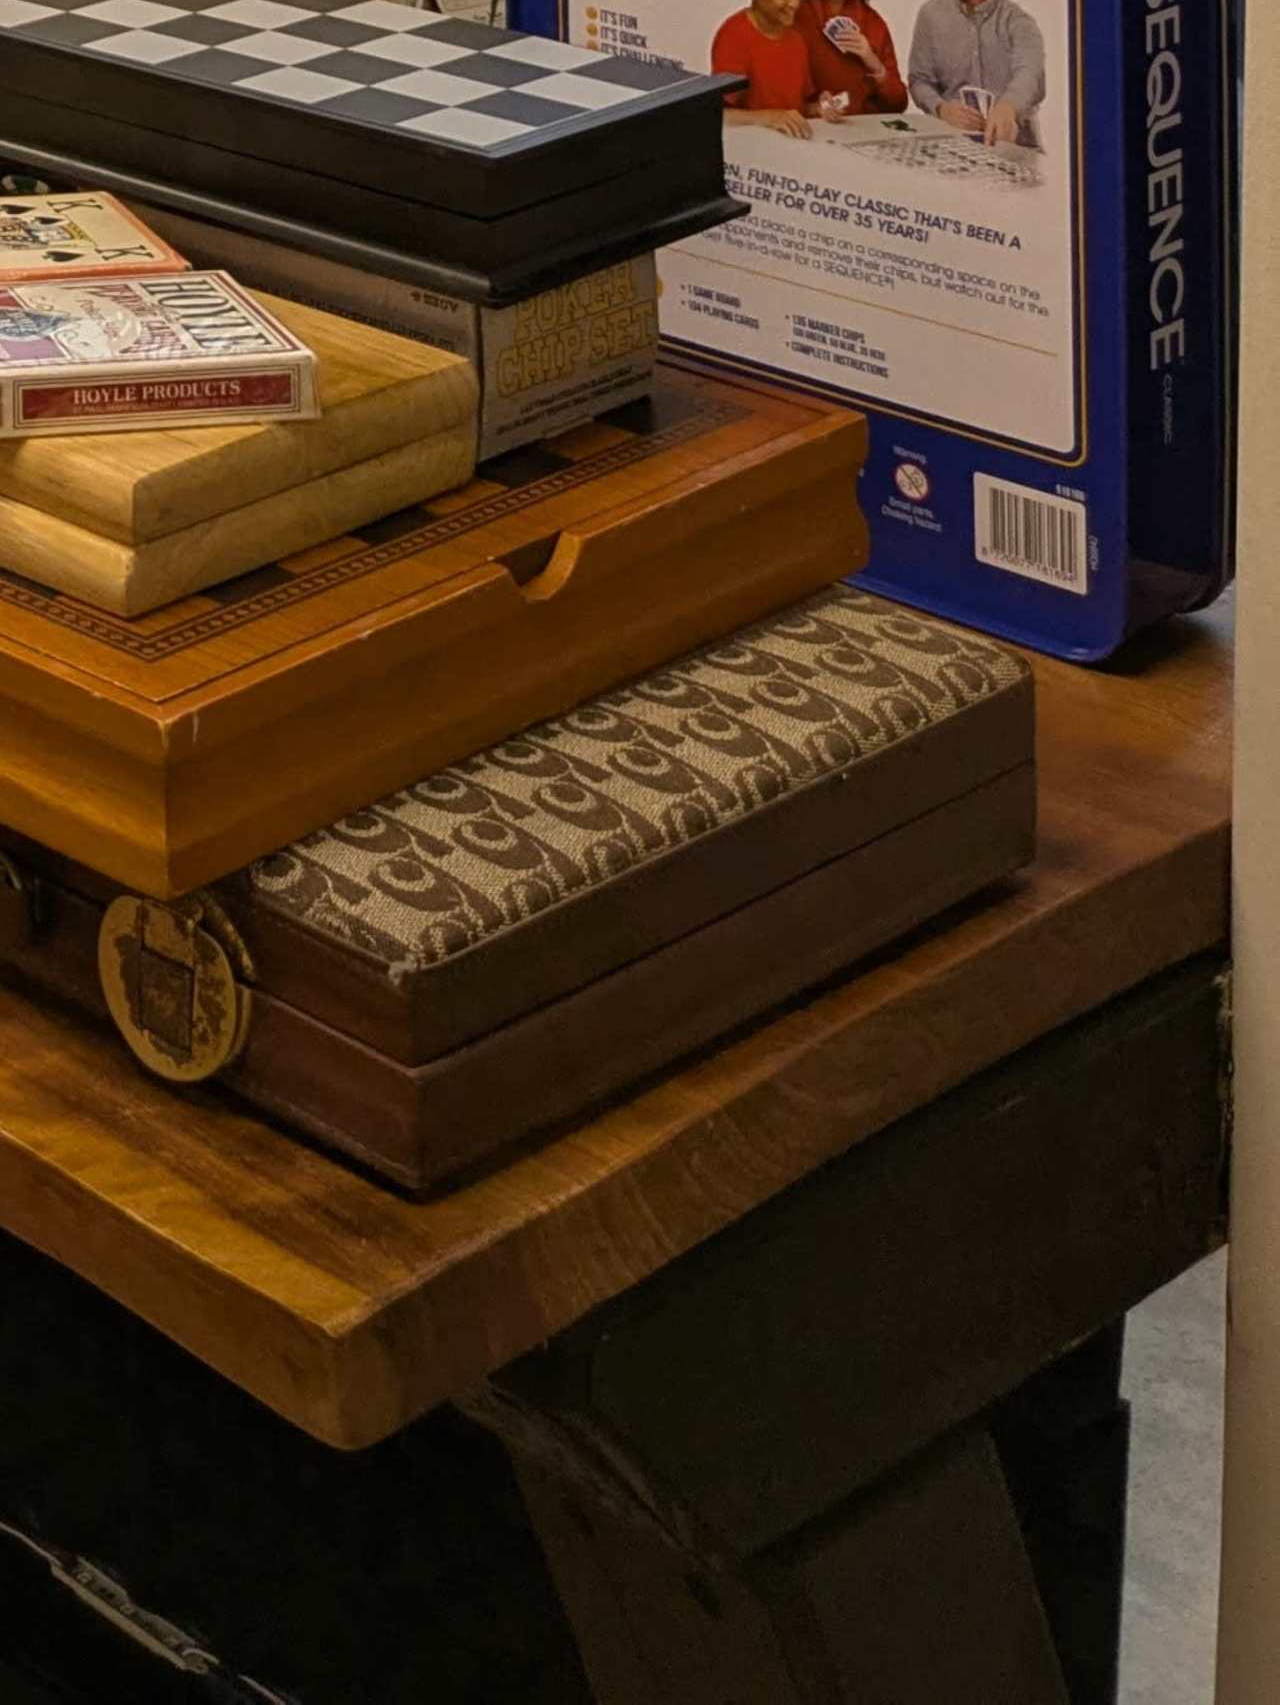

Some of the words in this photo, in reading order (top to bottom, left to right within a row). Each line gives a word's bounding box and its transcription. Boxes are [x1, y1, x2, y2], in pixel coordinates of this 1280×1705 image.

[599, 8, 618, 26] IT'S
[618, 12, 638, 31] FUN
[599, 25, 618, 43] IT'S
[618, 29, 648, 50] QUICK
[747, 167, 843, 205] FUN-TO-PLAY
[845, 192, 910, 222] CLASSIC
[912, 210, 963, 237] THAT'S
[966, 222, 1007, 247] BEEN
[1008, 236, 1022, 251] A
[775, 191, 806, 213] FOR
[810, 198, 851, 225] OVER
[853, 208, 875, 230] 35
[877, 216, 930, 244] YEARS!
[140, 279, 277, 353] HOYLE
[703, 304, 734, 323] PLAYING
[734, 312, 760, 330] CARDS
[807, 318, 841, 336] MARKER
[841, 327, 866, 344] CHIPS
[496, 324, 584, 398] CHIP
[589, 300, 657, 365] SET
[791, 341, 832, 362] COMPLETE
[832, 352, 889, 379] INSTRUCTIONS
[72, 385, 139, 405] HOYLE
[141, 379, 243, 402] PRODUCTS
